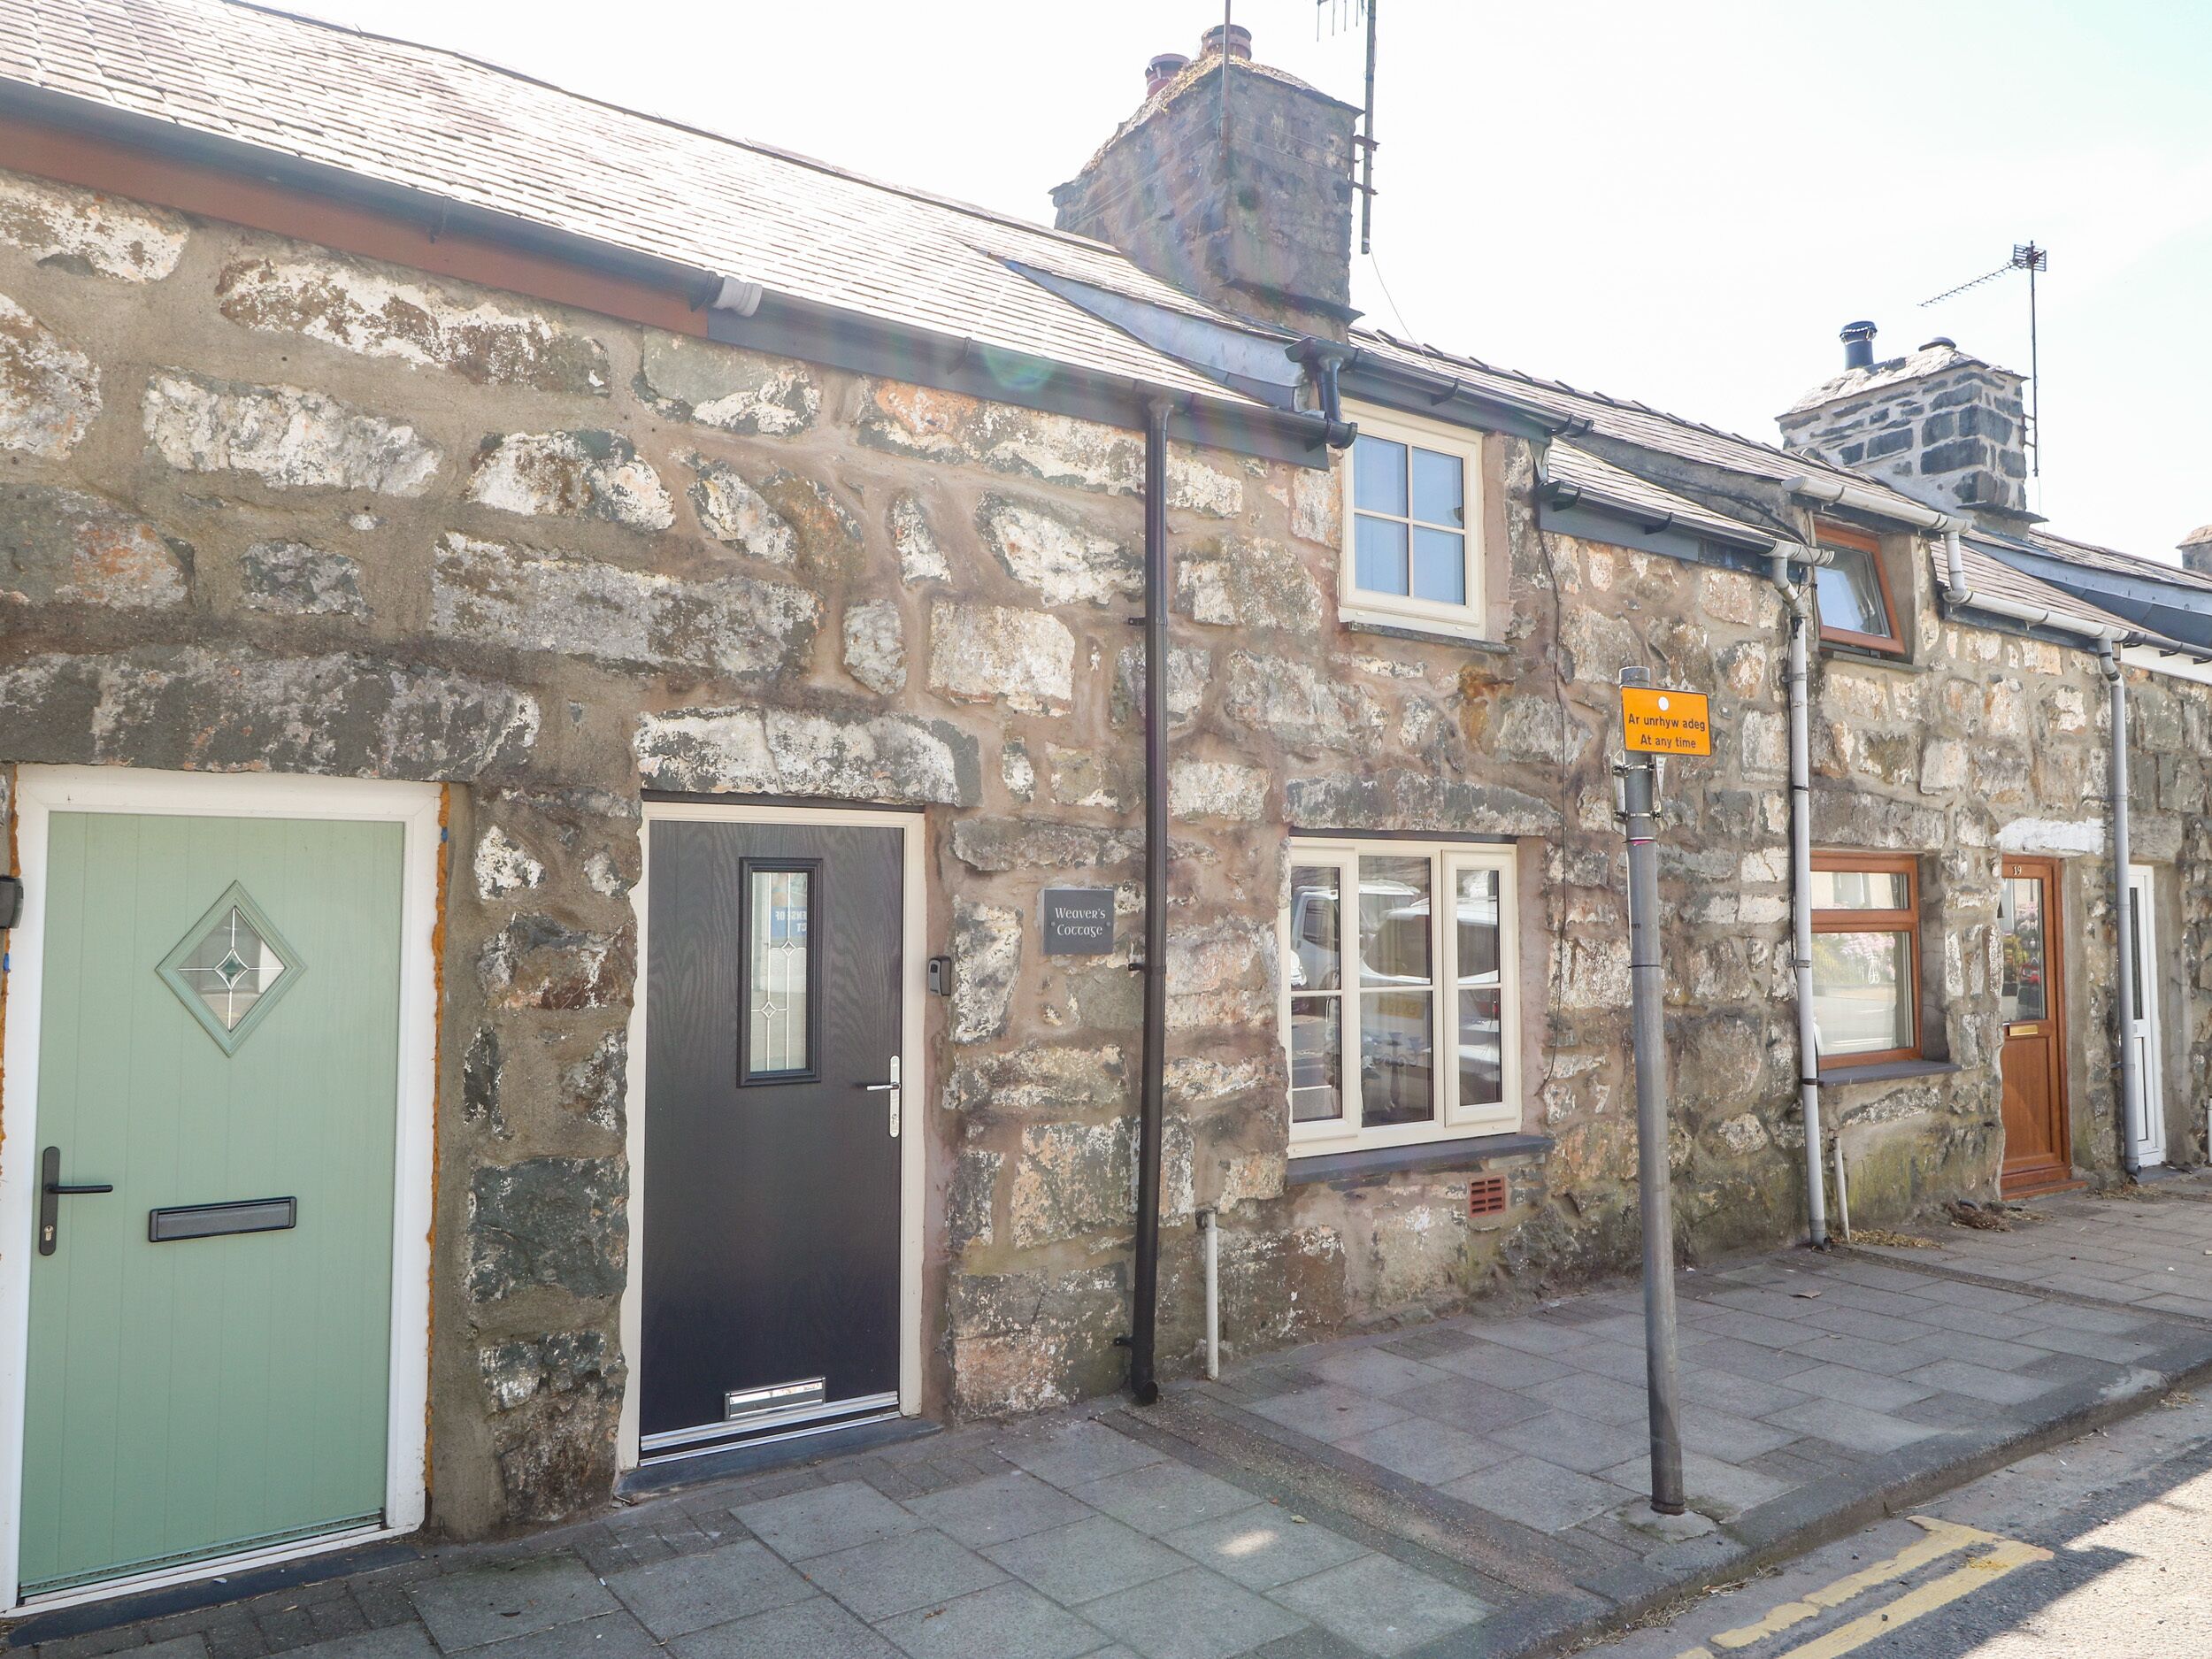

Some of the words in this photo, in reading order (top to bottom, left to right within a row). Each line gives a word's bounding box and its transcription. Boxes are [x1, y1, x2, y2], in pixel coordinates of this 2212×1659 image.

[1628, 713, 1640, 724] Ar
[1643, 717, 1679, 729] unrhyw
[1682, 718, 1706, 732] adeg
[1640, 733, 1652, 745] At
[1655, 737, 1672, 749] any
[1675, 737, 1696, 749] time
[2013, 864, 2022, 876] 19
[1055, 907, 1106, 919] Weaver's
[1056, 924, 1102, 938] Cottage
